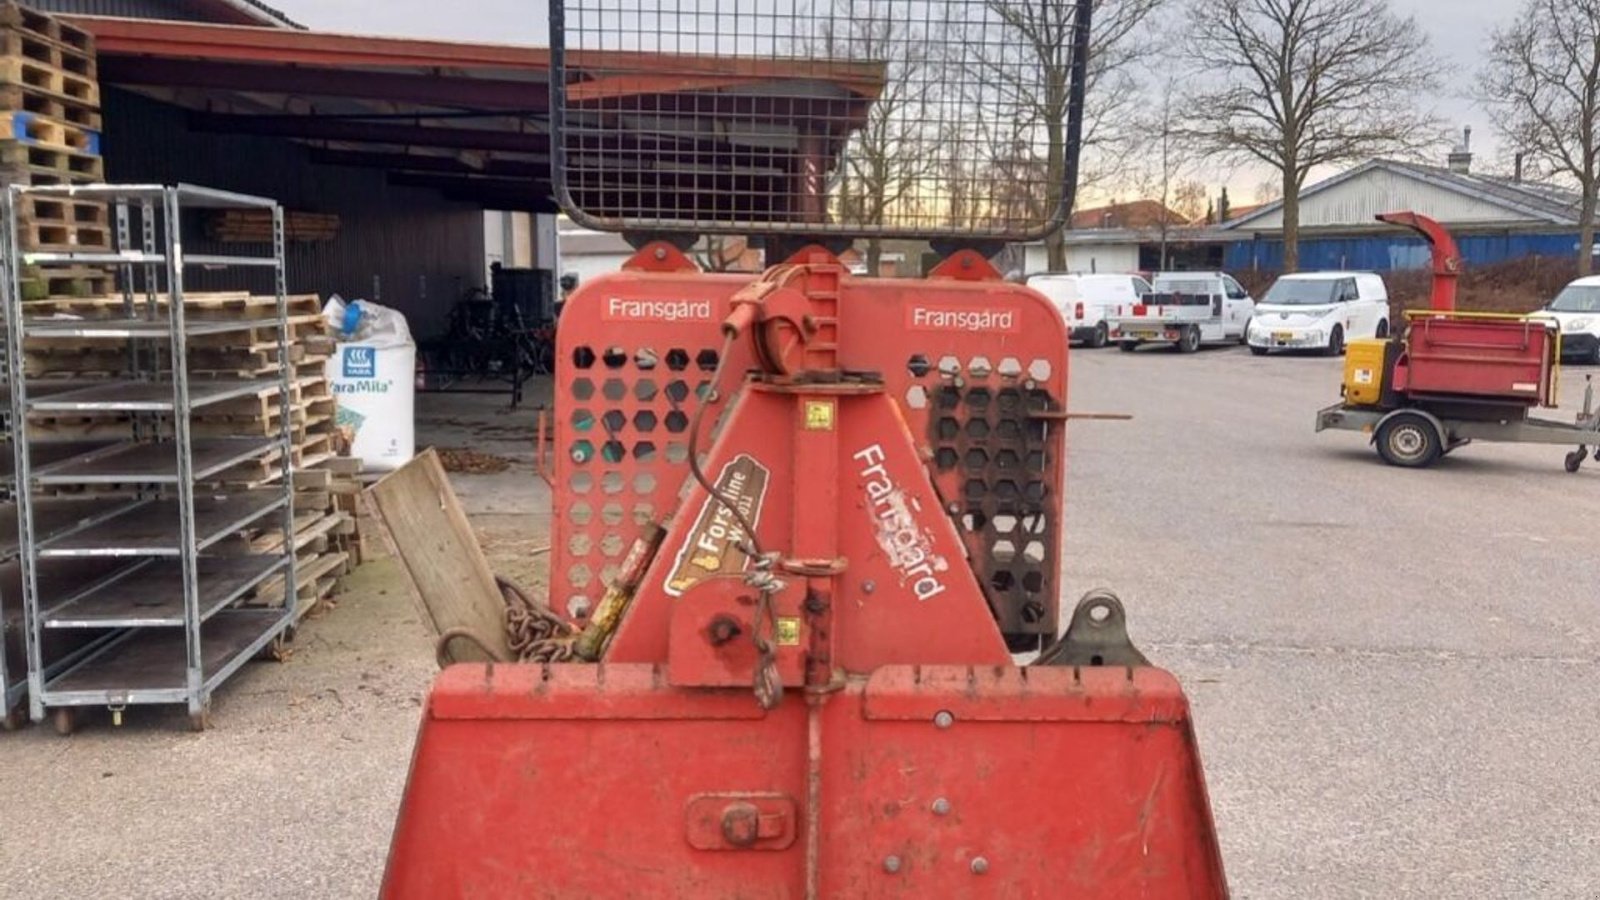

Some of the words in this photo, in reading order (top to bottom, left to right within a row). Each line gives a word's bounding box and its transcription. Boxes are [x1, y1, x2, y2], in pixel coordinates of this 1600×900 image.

[609, 298, 710, 321] Fransgård
[914, 307, 1012, 331] Fransgård
[697, 471, 746, 552] Forsline
[726, 495, 753, 542] W-011
